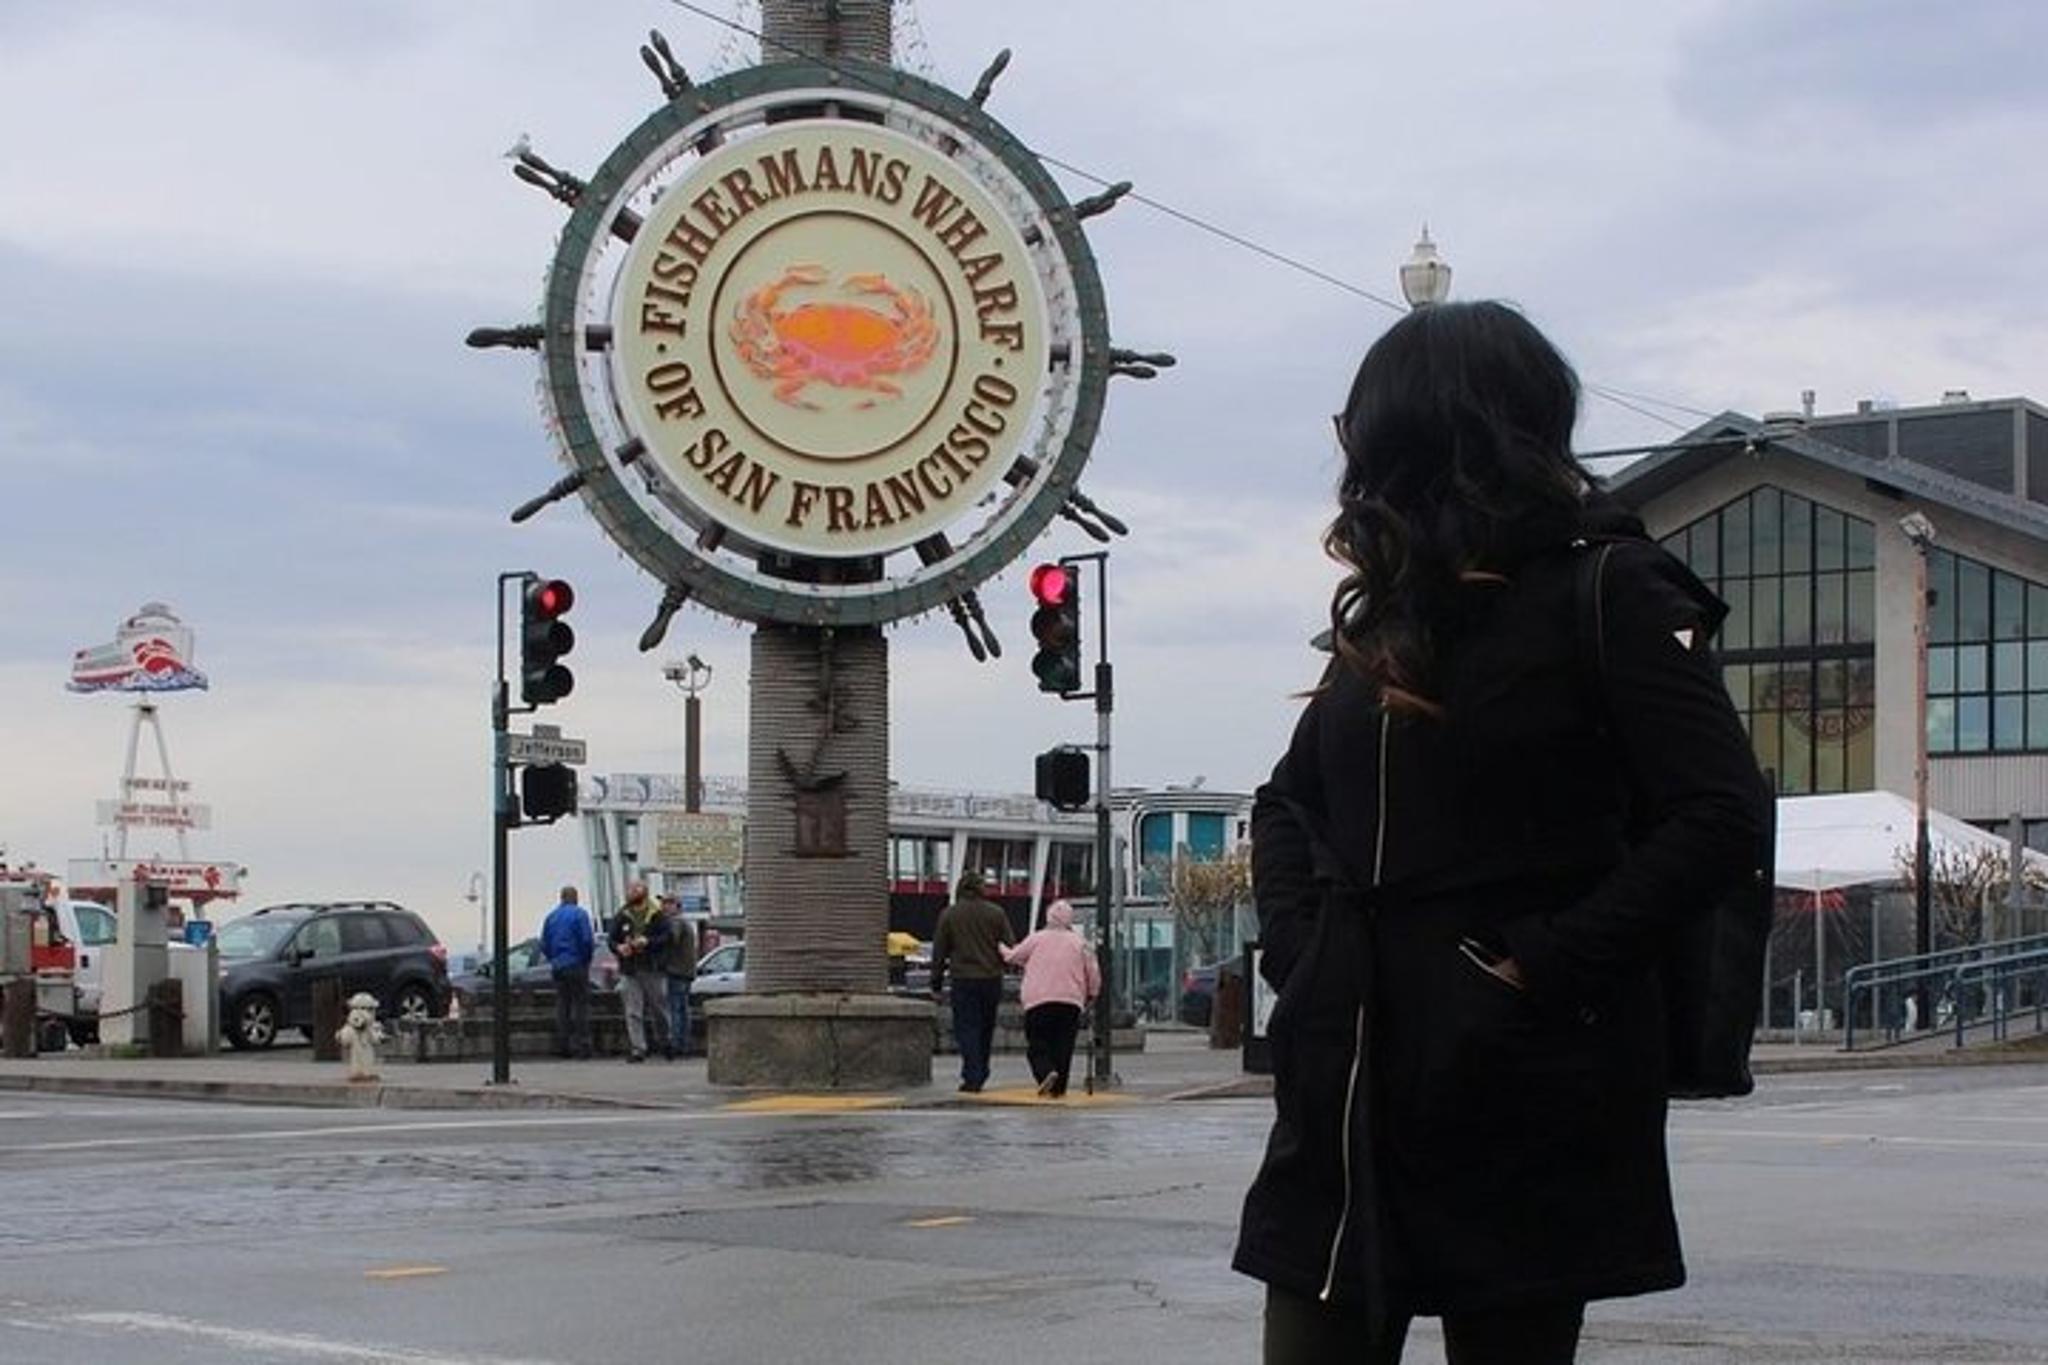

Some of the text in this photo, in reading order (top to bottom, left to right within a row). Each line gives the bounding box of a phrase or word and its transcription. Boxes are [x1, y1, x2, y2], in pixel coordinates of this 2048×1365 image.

[642, 146, 1024, 353] FISHERMANS WHARF
[644, 361, 1018, 533] OF SAN FRANCISCO
[516, 740, 581, 758] Jefferson
